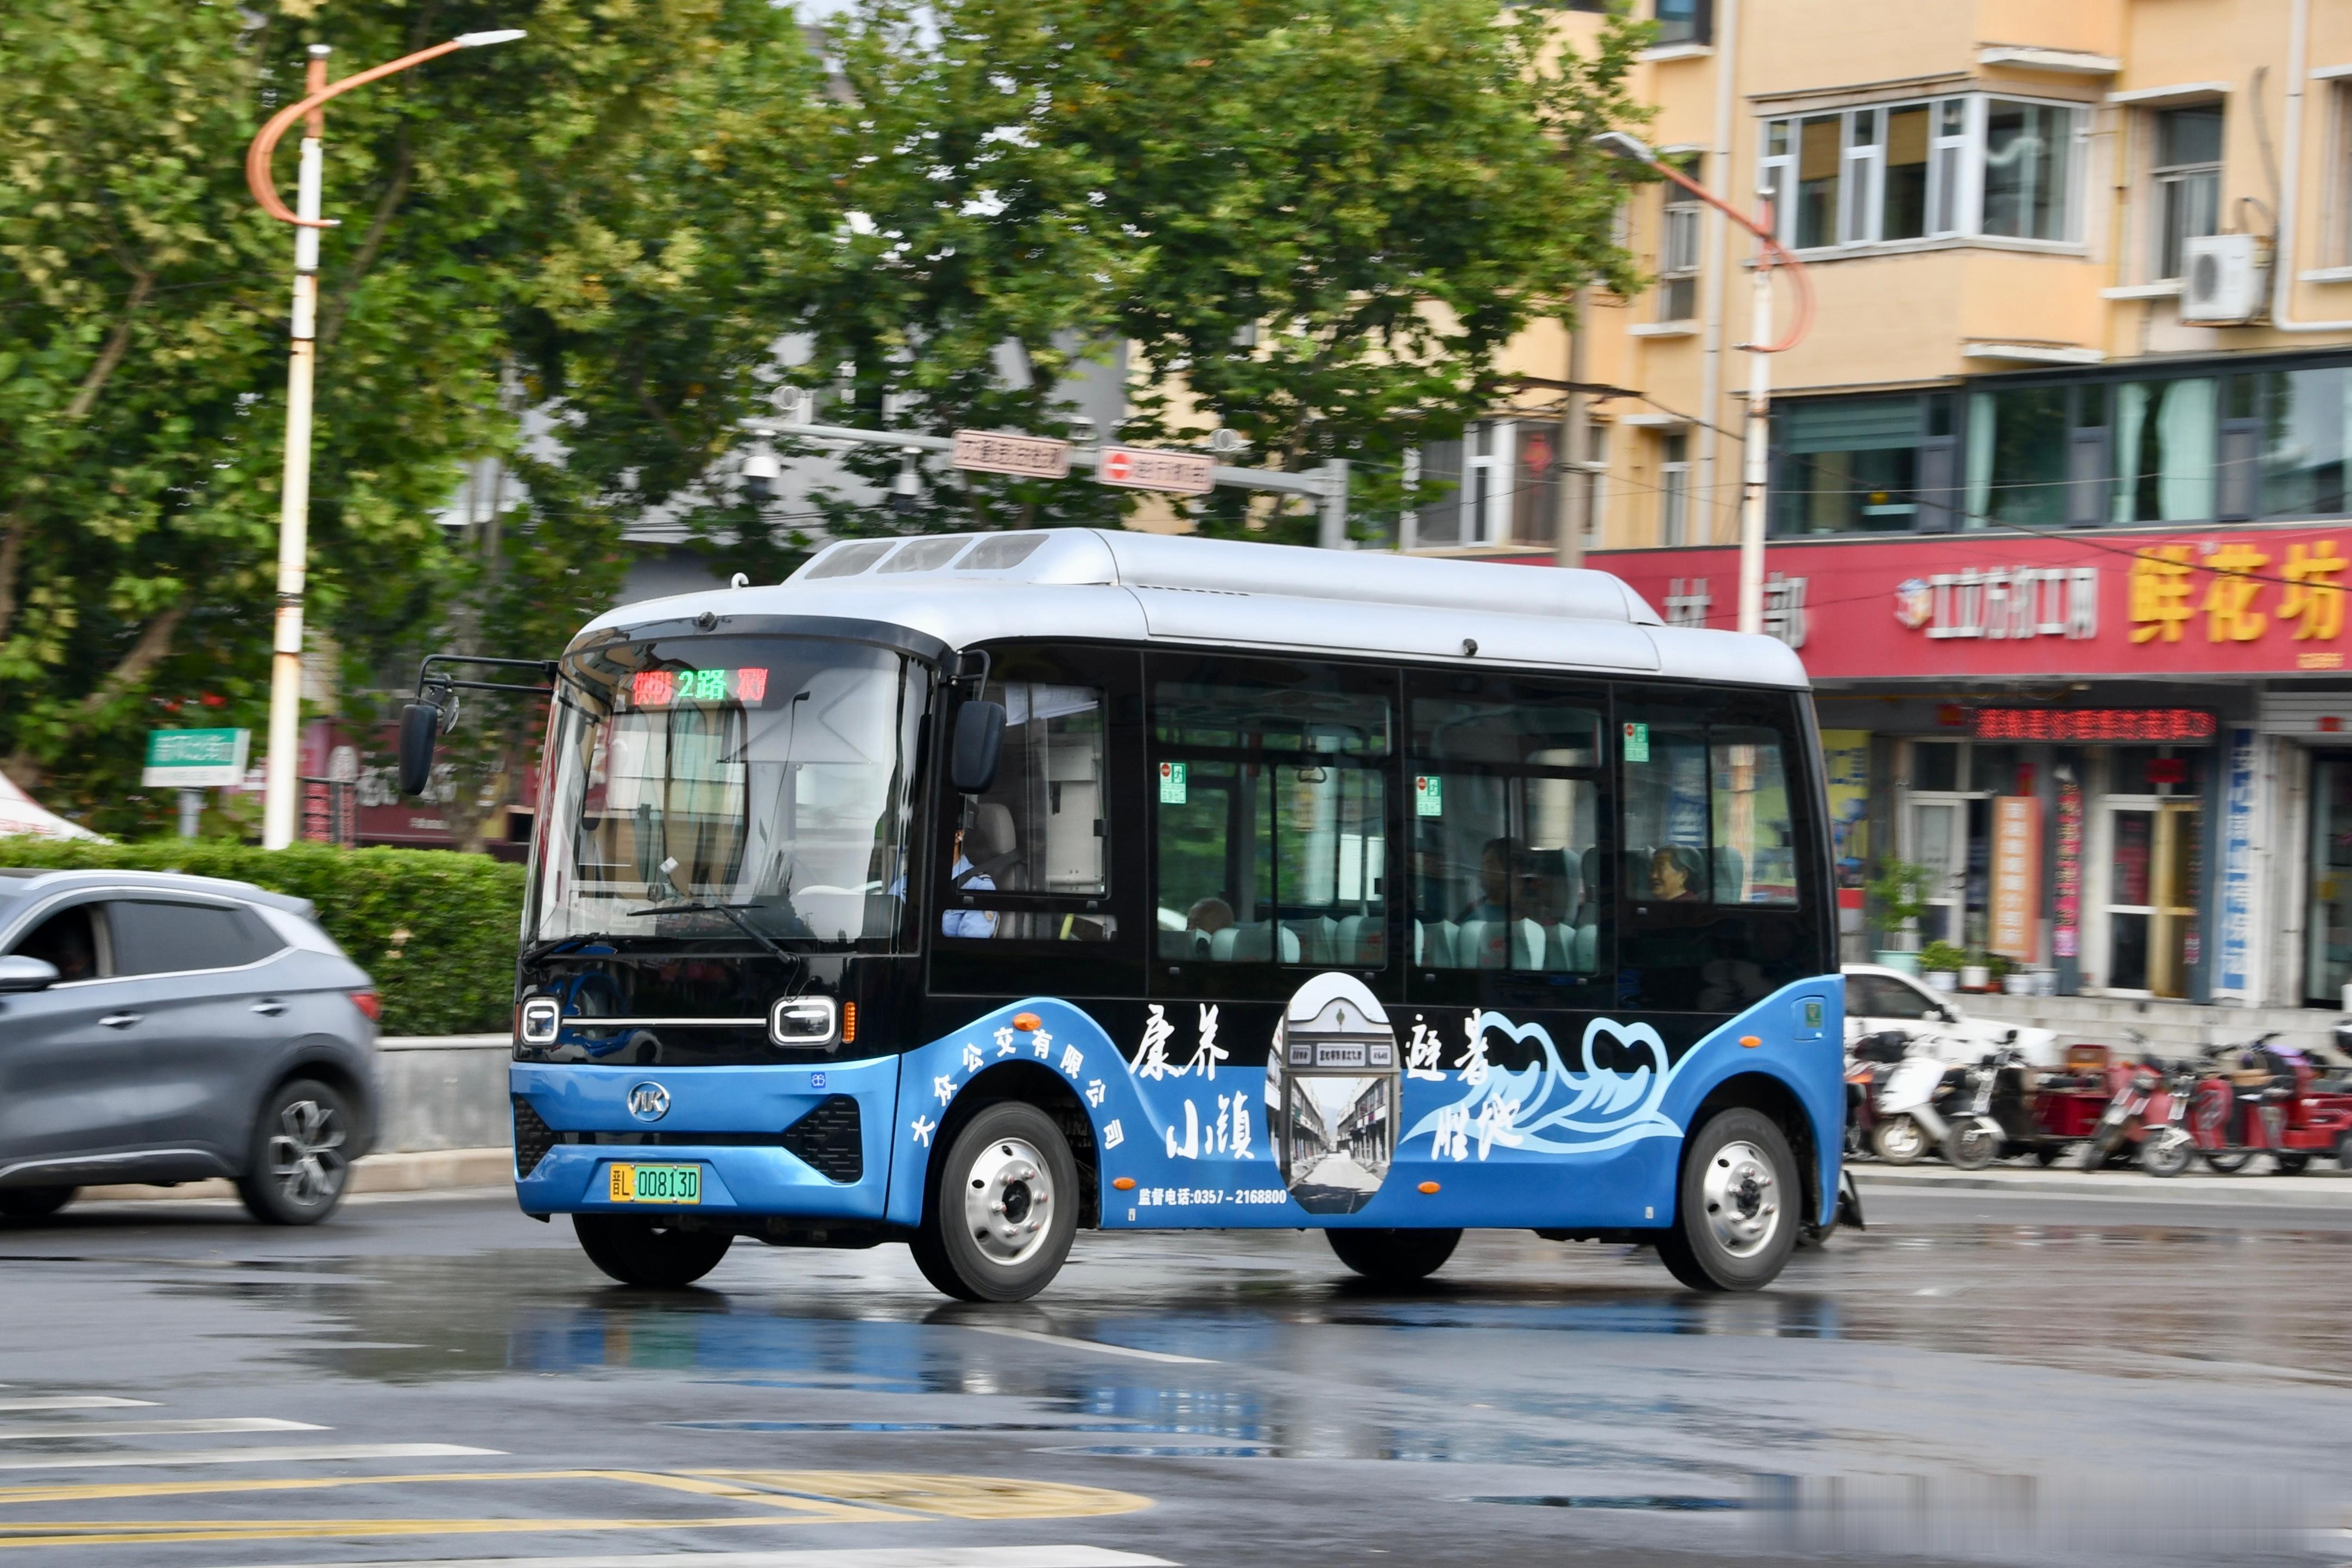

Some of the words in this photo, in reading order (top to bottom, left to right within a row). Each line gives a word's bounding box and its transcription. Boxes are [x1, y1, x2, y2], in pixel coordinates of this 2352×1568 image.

[2127, 540, 2349, 644] 鲜花坊
[678, 669, 727, 700] 2路
[911, 1026, 1124, 1150] 大众公交有限公司
